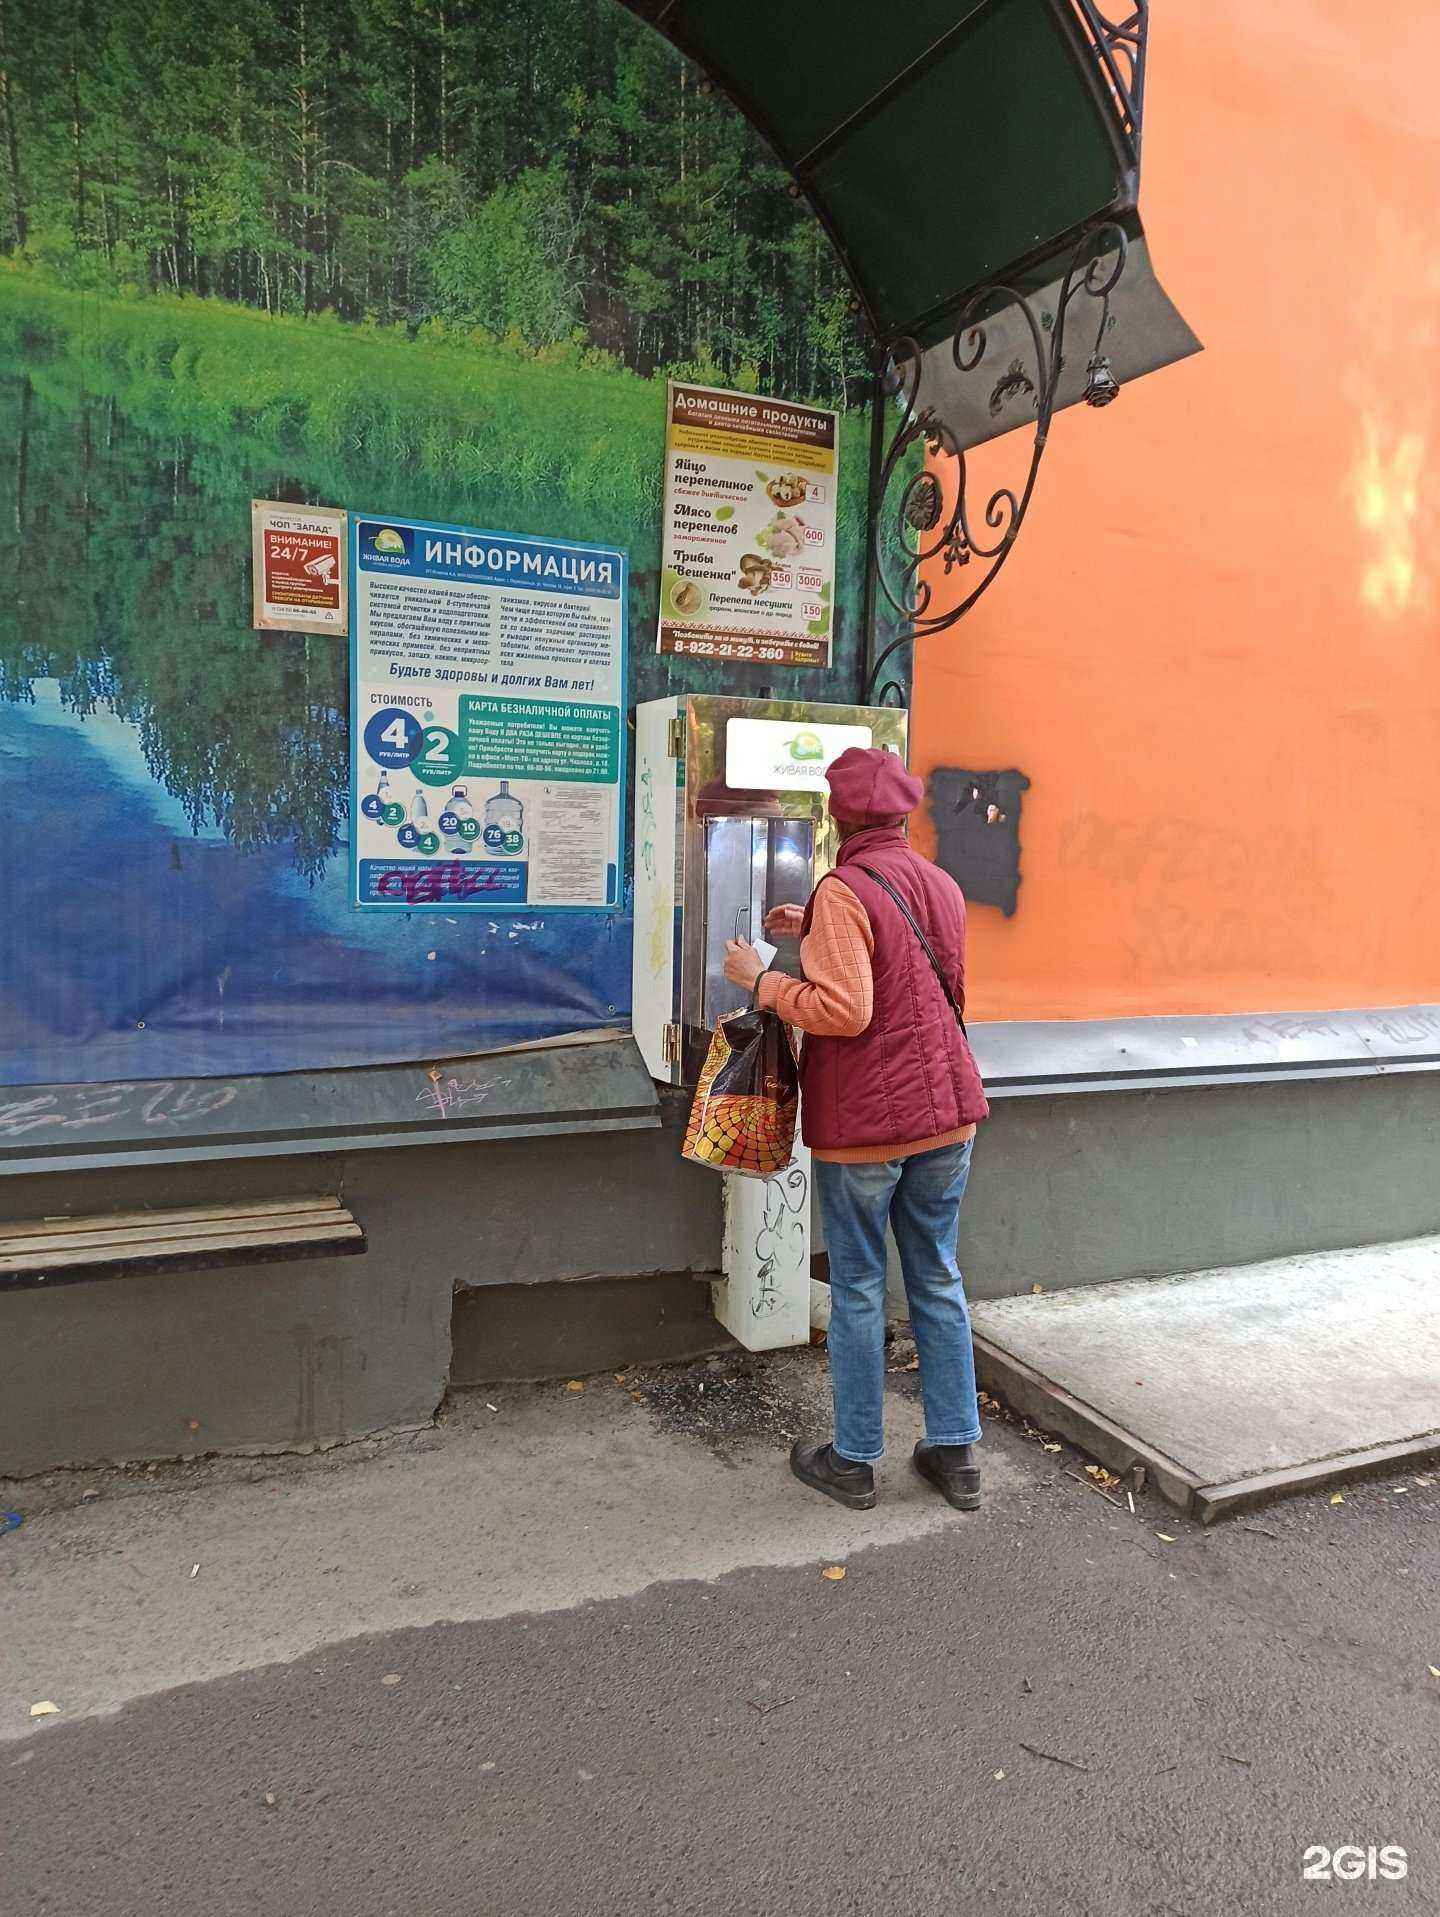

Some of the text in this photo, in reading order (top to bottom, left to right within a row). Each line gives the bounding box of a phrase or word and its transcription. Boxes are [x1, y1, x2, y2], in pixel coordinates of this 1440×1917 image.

[675, 392, 826, 430] Домашние продукты
[674, 458, 706, 474] Яйцо
[674, 474, 754, 492] перепелиное
[812, 486, 818, 497] 4
[674, 504, 712, 518] Мясо
[270, 521, 332, 534] ЧОП "ЗАПАД"
[673, 520, 738, 535] перепелов
[270, 535, 332, 549] ВНИМАНИЕ!
[806, 530, 822, 541] 600
[270, 546, 308, 560] 24/7
[362, 552, 390, 562] ЖИВАЯ
[391, 556, 411, 565] ВОДА
[673, 550, 714, 564] Грибы
[425, 540, 612, 584] ИНФОРМАЦИЯ
[668, 564, 736, 580] "Вешенка"
[772, 572, 790, 583] 350
[799, 575, 821, 587] 3000
[709, 593, 792, 609] Перепела несушки
[804, 605, 820, 616] 150
[389, 663, 594, 691] Будьте здоровы и долгих Вам лет!
[370, 693, 433, 708] СТОИМОСТЬ
[468, 700, 610, 720] КАРТА БЕЗНАЛИЧНОЙ ОПЛАТЫ
[381, 718, 408, 749] 4
[426, 731, 449, 761] 2
[772, 764, 808, 776] ЖИВАЯ
[369, 801, 378, 809] 4
[390, 808, 396, 816] 2
[442, 818, 457, 826] 20
[463, 823, 475, 831] 10
[405, 831, 413, 839] 8
[488, 830, 501, 838] 76
[506, 834, 519, 843] 38
[424, 838, 432, 846] 4
